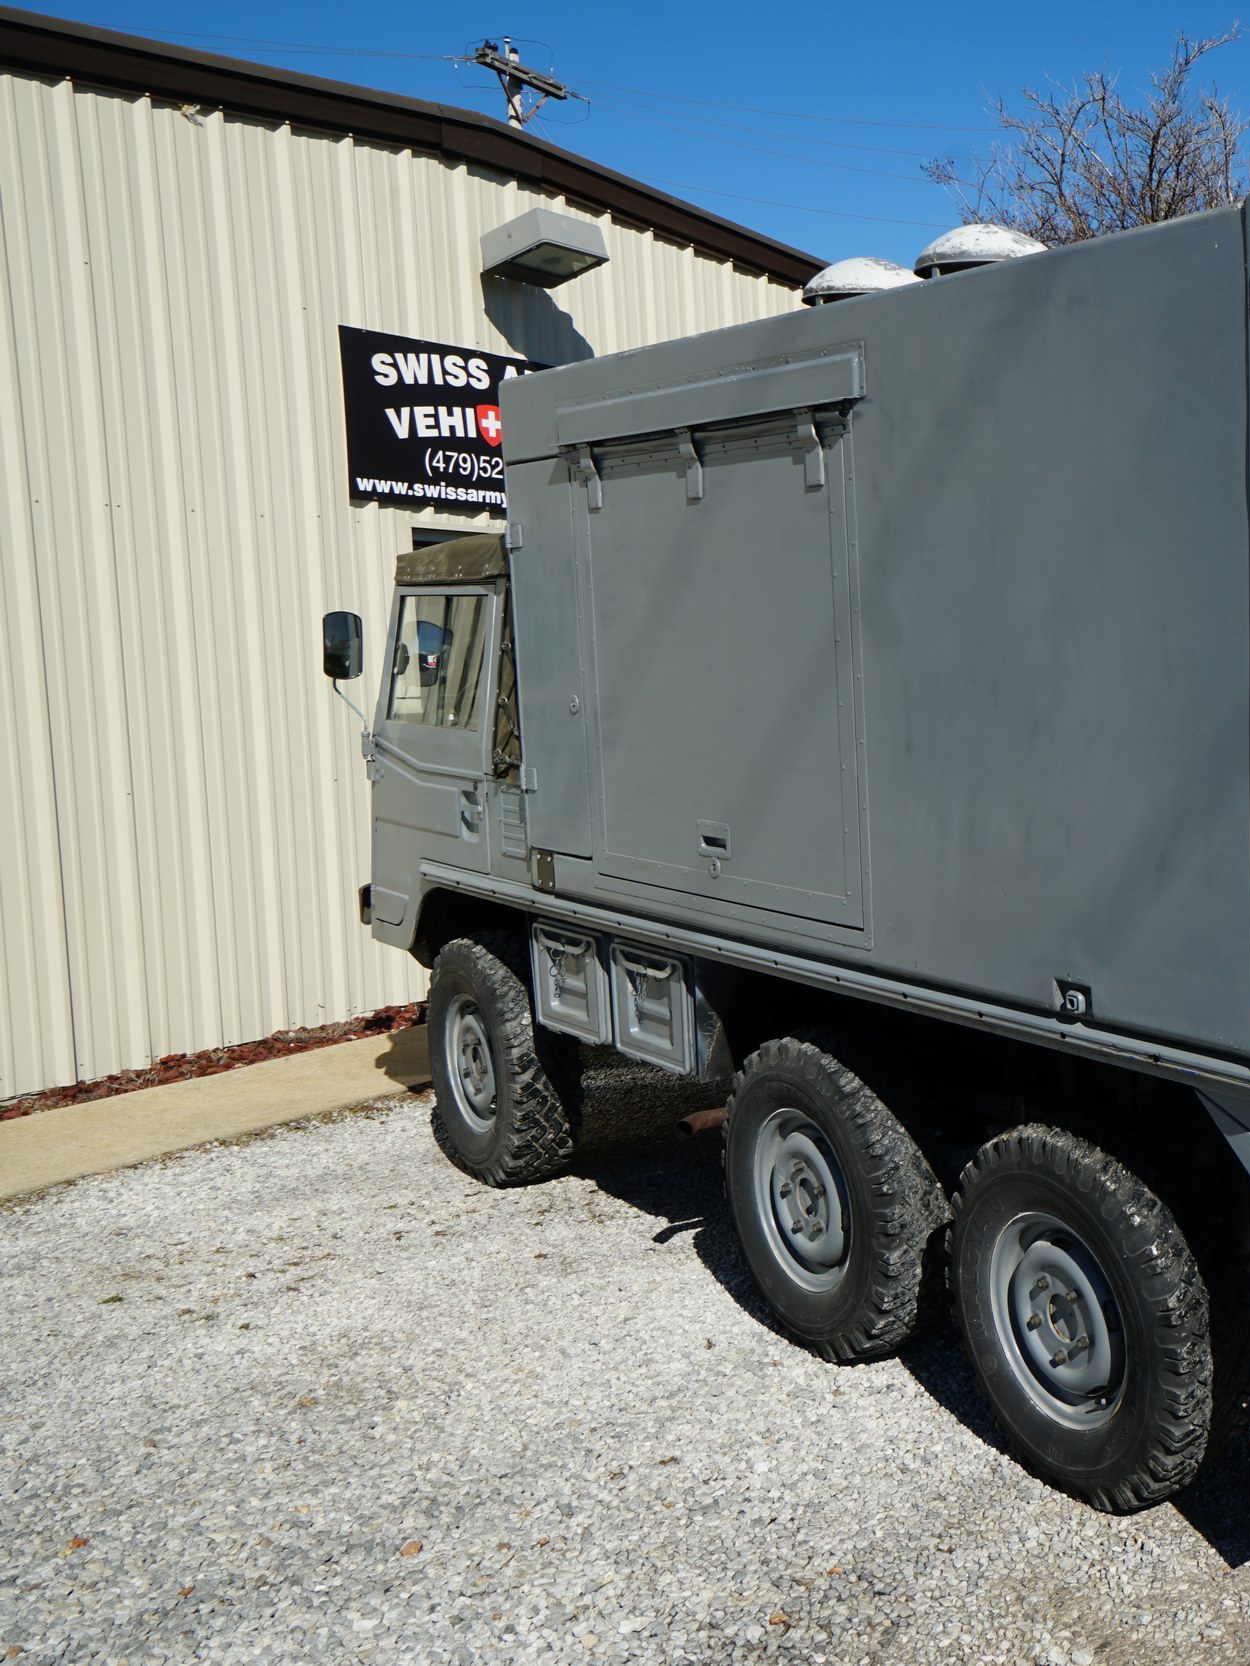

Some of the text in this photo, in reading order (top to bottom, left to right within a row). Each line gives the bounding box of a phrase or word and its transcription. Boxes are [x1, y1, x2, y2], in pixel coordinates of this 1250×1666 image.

[371, 352, 490, 390] SWISS
[384, 406, 477, 440] VEHI
[425, 447, 504, 482] (479)52
